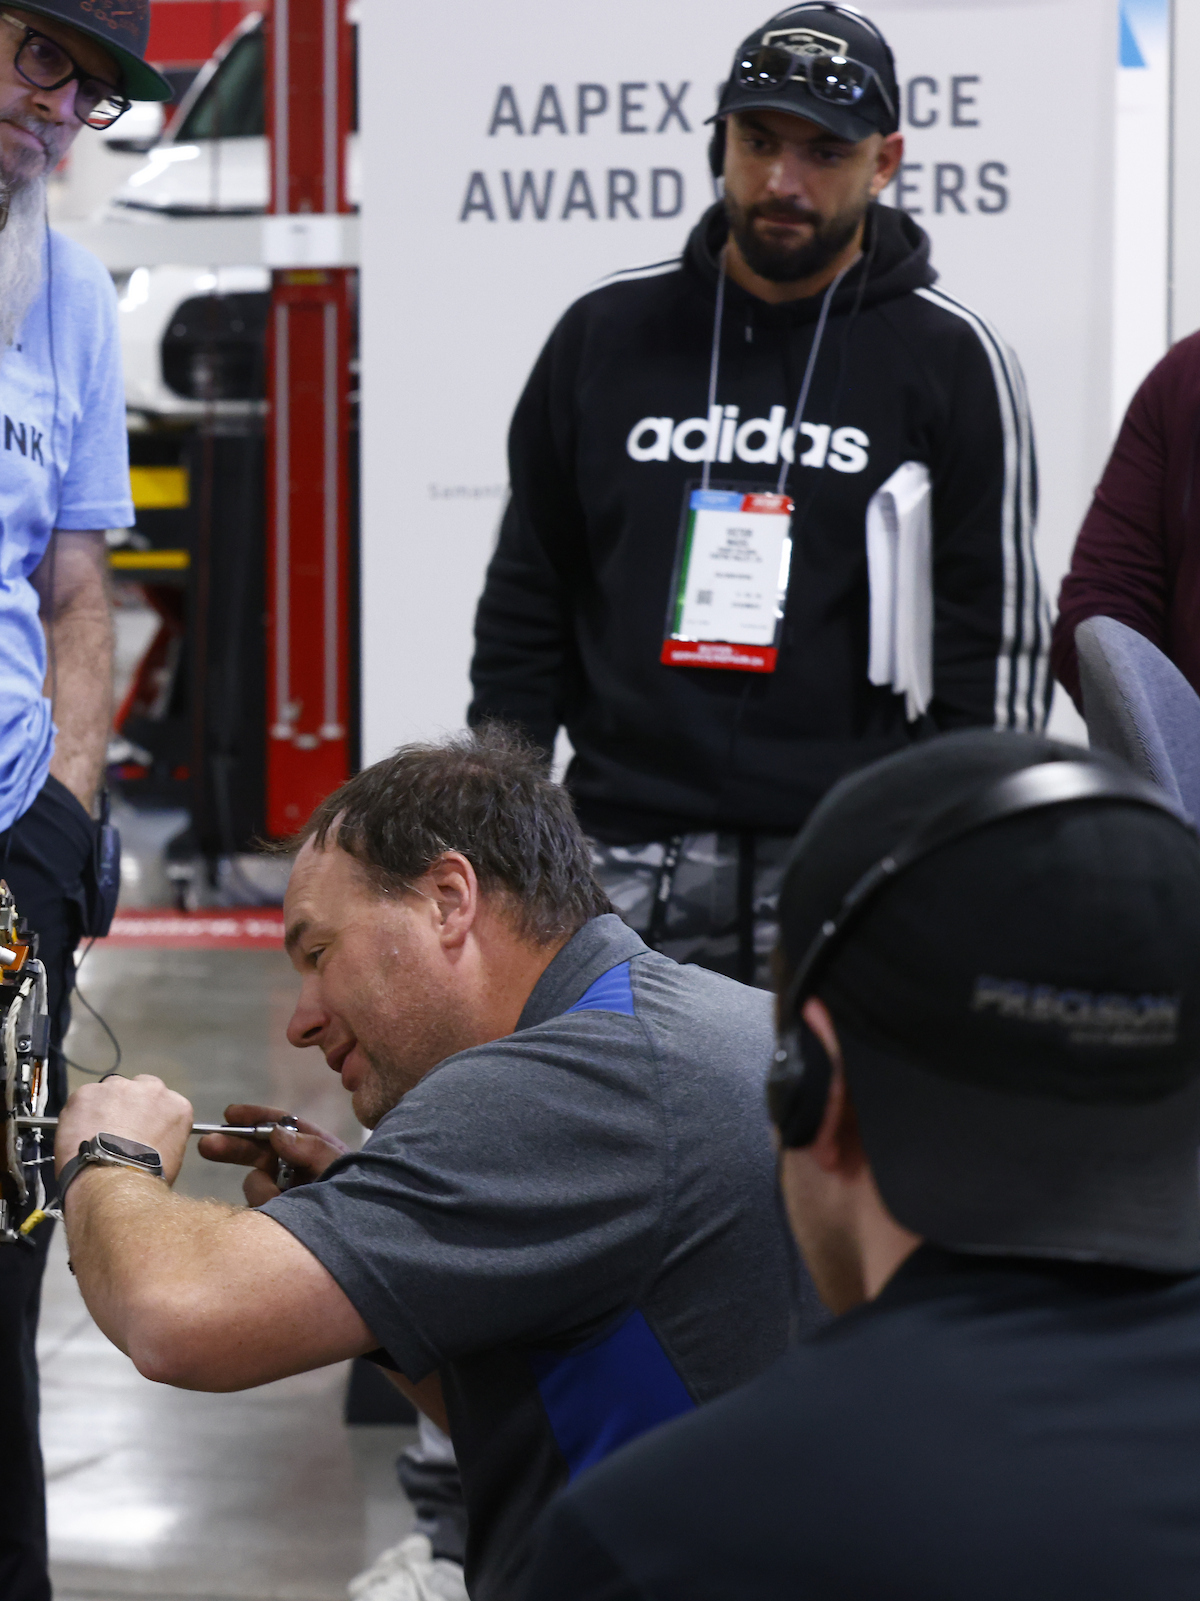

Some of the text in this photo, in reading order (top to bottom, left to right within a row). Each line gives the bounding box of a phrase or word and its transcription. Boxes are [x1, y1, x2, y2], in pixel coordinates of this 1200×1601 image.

[487, 81, 693, 137] AAPEX
[458, 167, 686, 222] AWARD
[627, 404, 870, 474] adidas
